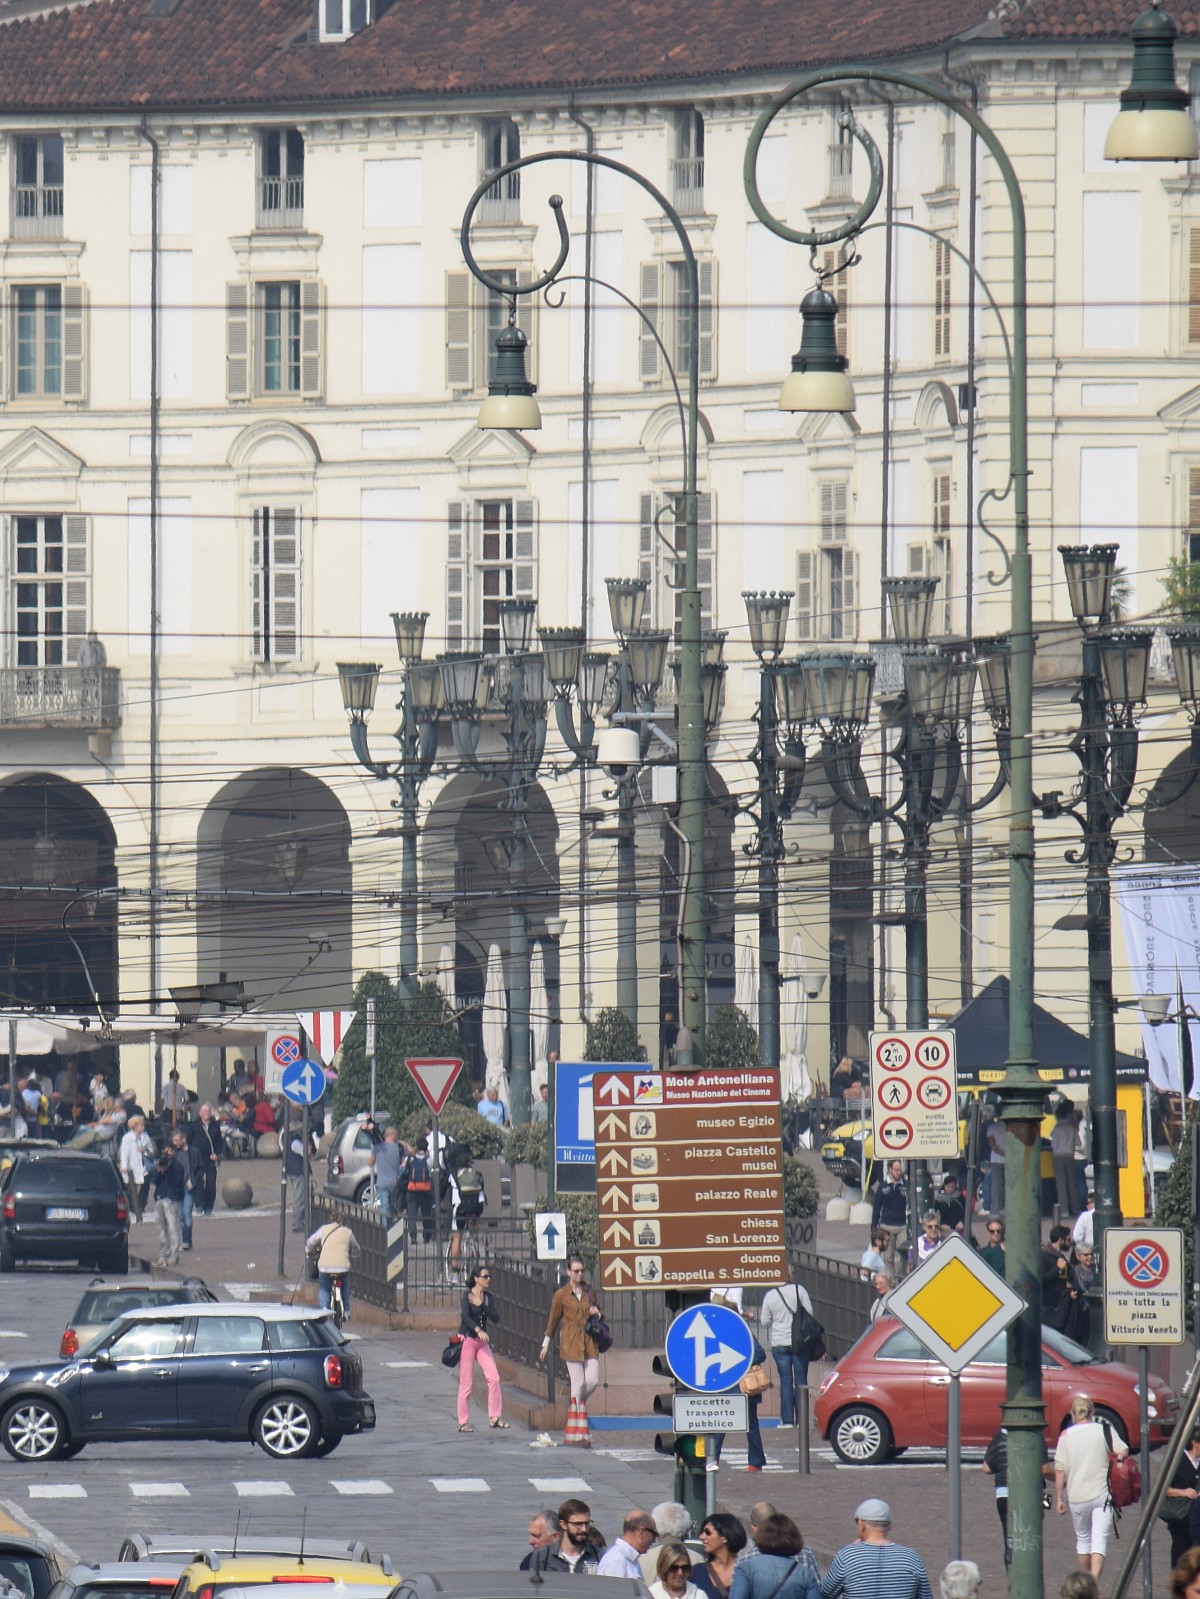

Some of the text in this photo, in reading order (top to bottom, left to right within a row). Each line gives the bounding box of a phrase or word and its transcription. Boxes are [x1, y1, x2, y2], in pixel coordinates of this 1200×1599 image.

[923, 1047, 940, 1061] 10
[666, 1074, 774, 1087] Mole Antonelliana
[666, 1088, 771, 1099] Museo Nazionale del Cinema
[697, 1116, 775, 1128] museo Egizio
[685, 1145, 776, 1159] piazza Castello
[742, 1160, 777, 1170] musei
[695, 1188, 778, 1201] palazzo Reale
[741, 1217, 779, 1228] chiesa
[706, 1233, 780, 1244] San Lorenzo
[740, 1253, 781, 1263] duomo
[664, 1267, 781, 1281] cappella S. Sindone
[1118, 1297, 1170, 1306] su tutta la
[1131, 1311, 1157, 1321] piazza
[1111, 1325, 1178, 1334] Vittorio Veneto
[690, 1398, 731, 1406] eccetto
[686, 1410, 735, 1418] trasporto
[688, 1420, 733, 1429] pubblico
